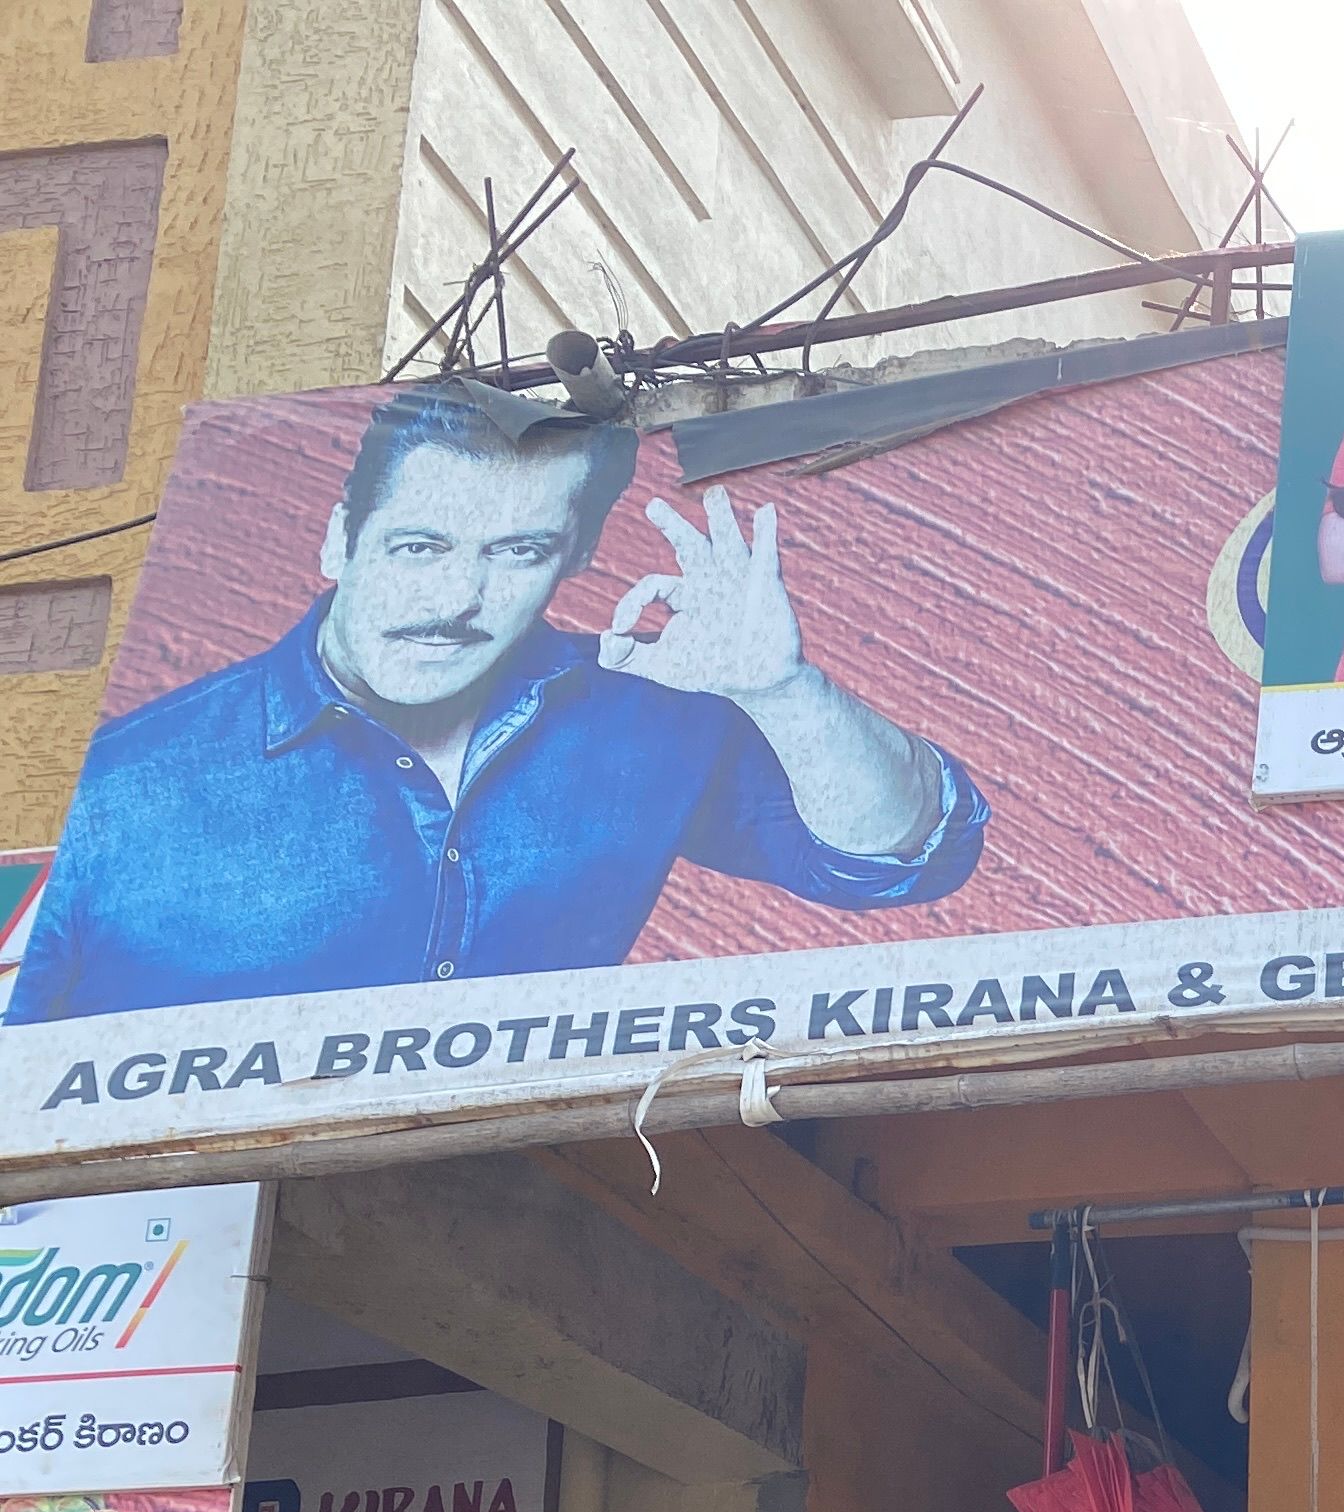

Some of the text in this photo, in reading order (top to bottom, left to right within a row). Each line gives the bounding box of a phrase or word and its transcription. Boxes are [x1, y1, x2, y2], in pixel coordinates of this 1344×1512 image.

[40, 1040, 284, 1111] AGRA
[309, 997, 777, 1081] BROTHERS
[808, 966, 1136, 1044] KIRANA
[1166, 960, 1227, 1008] &
[51, 1324, 104, 1353] Oils
[73, 1411, 190, 1450] కిరాణం
